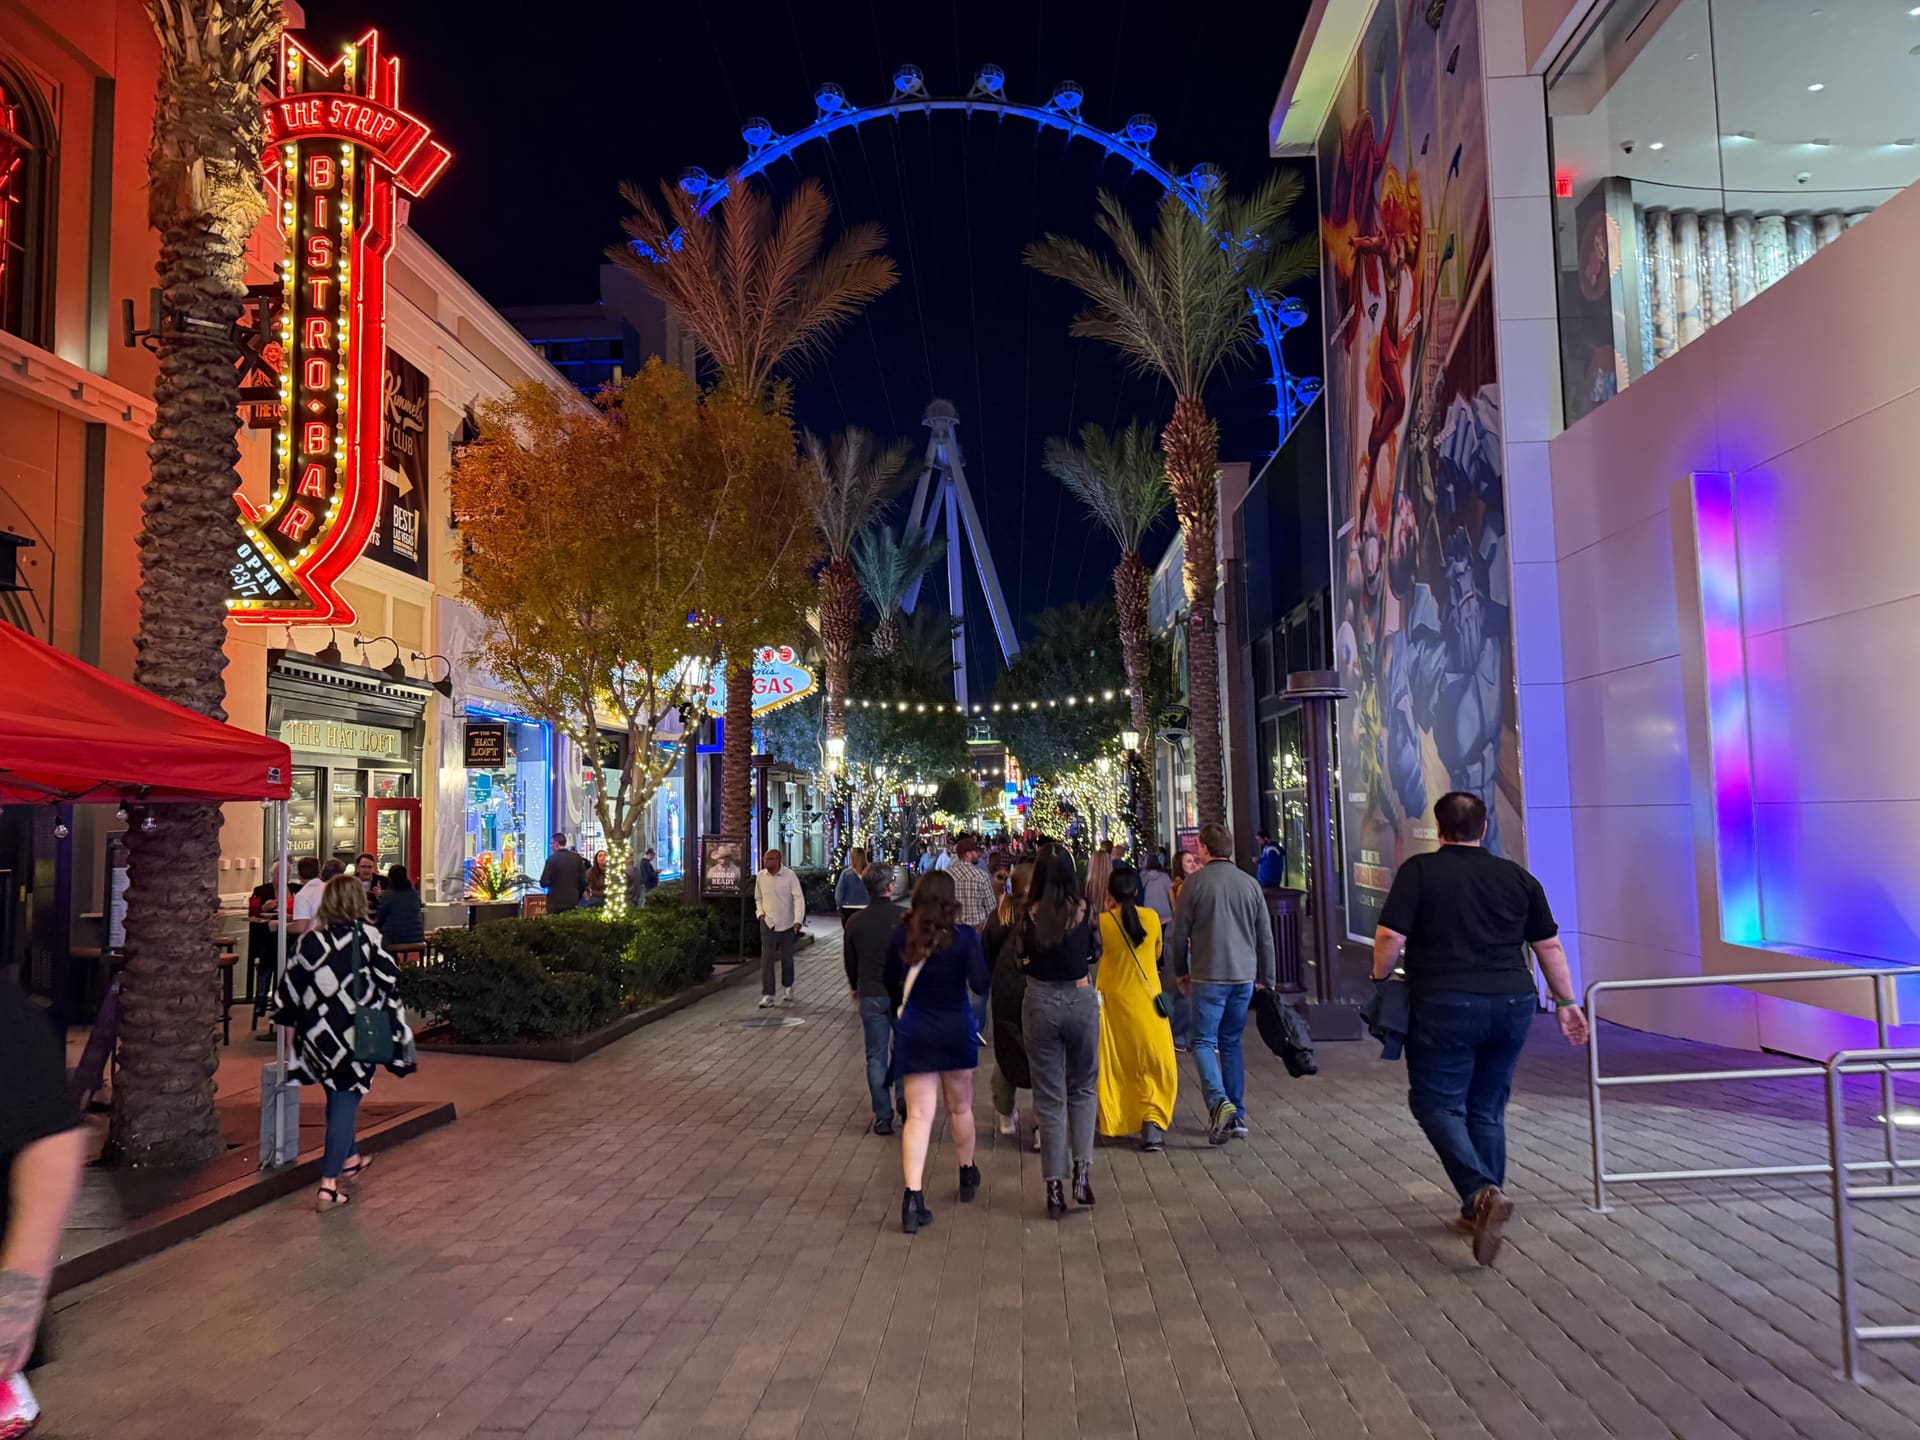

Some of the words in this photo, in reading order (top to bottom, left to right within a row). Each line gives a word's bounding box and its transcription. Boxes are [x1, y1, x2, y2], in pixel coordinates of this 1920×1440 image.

[281, 100, 321, 130] THE
[328, 100, 399, 140] STRIP
[304, 155, 334, 390] BISTRO
[392, 426, 414, 456] CLUB
[277, 421, 331, 542] BAR
[229, 563, 260, 597] 23/7
[236, 543, 281, 596] OPEN
[750, 677, 795, 695] GAS
[286, 722, 321, 746] THE
[326, 726, 358, 750] HAT
[359, 729, 396, 753] LOFT
[471, 747, 499, 756] LOFT
[474, 738, 496, 747] HAT
